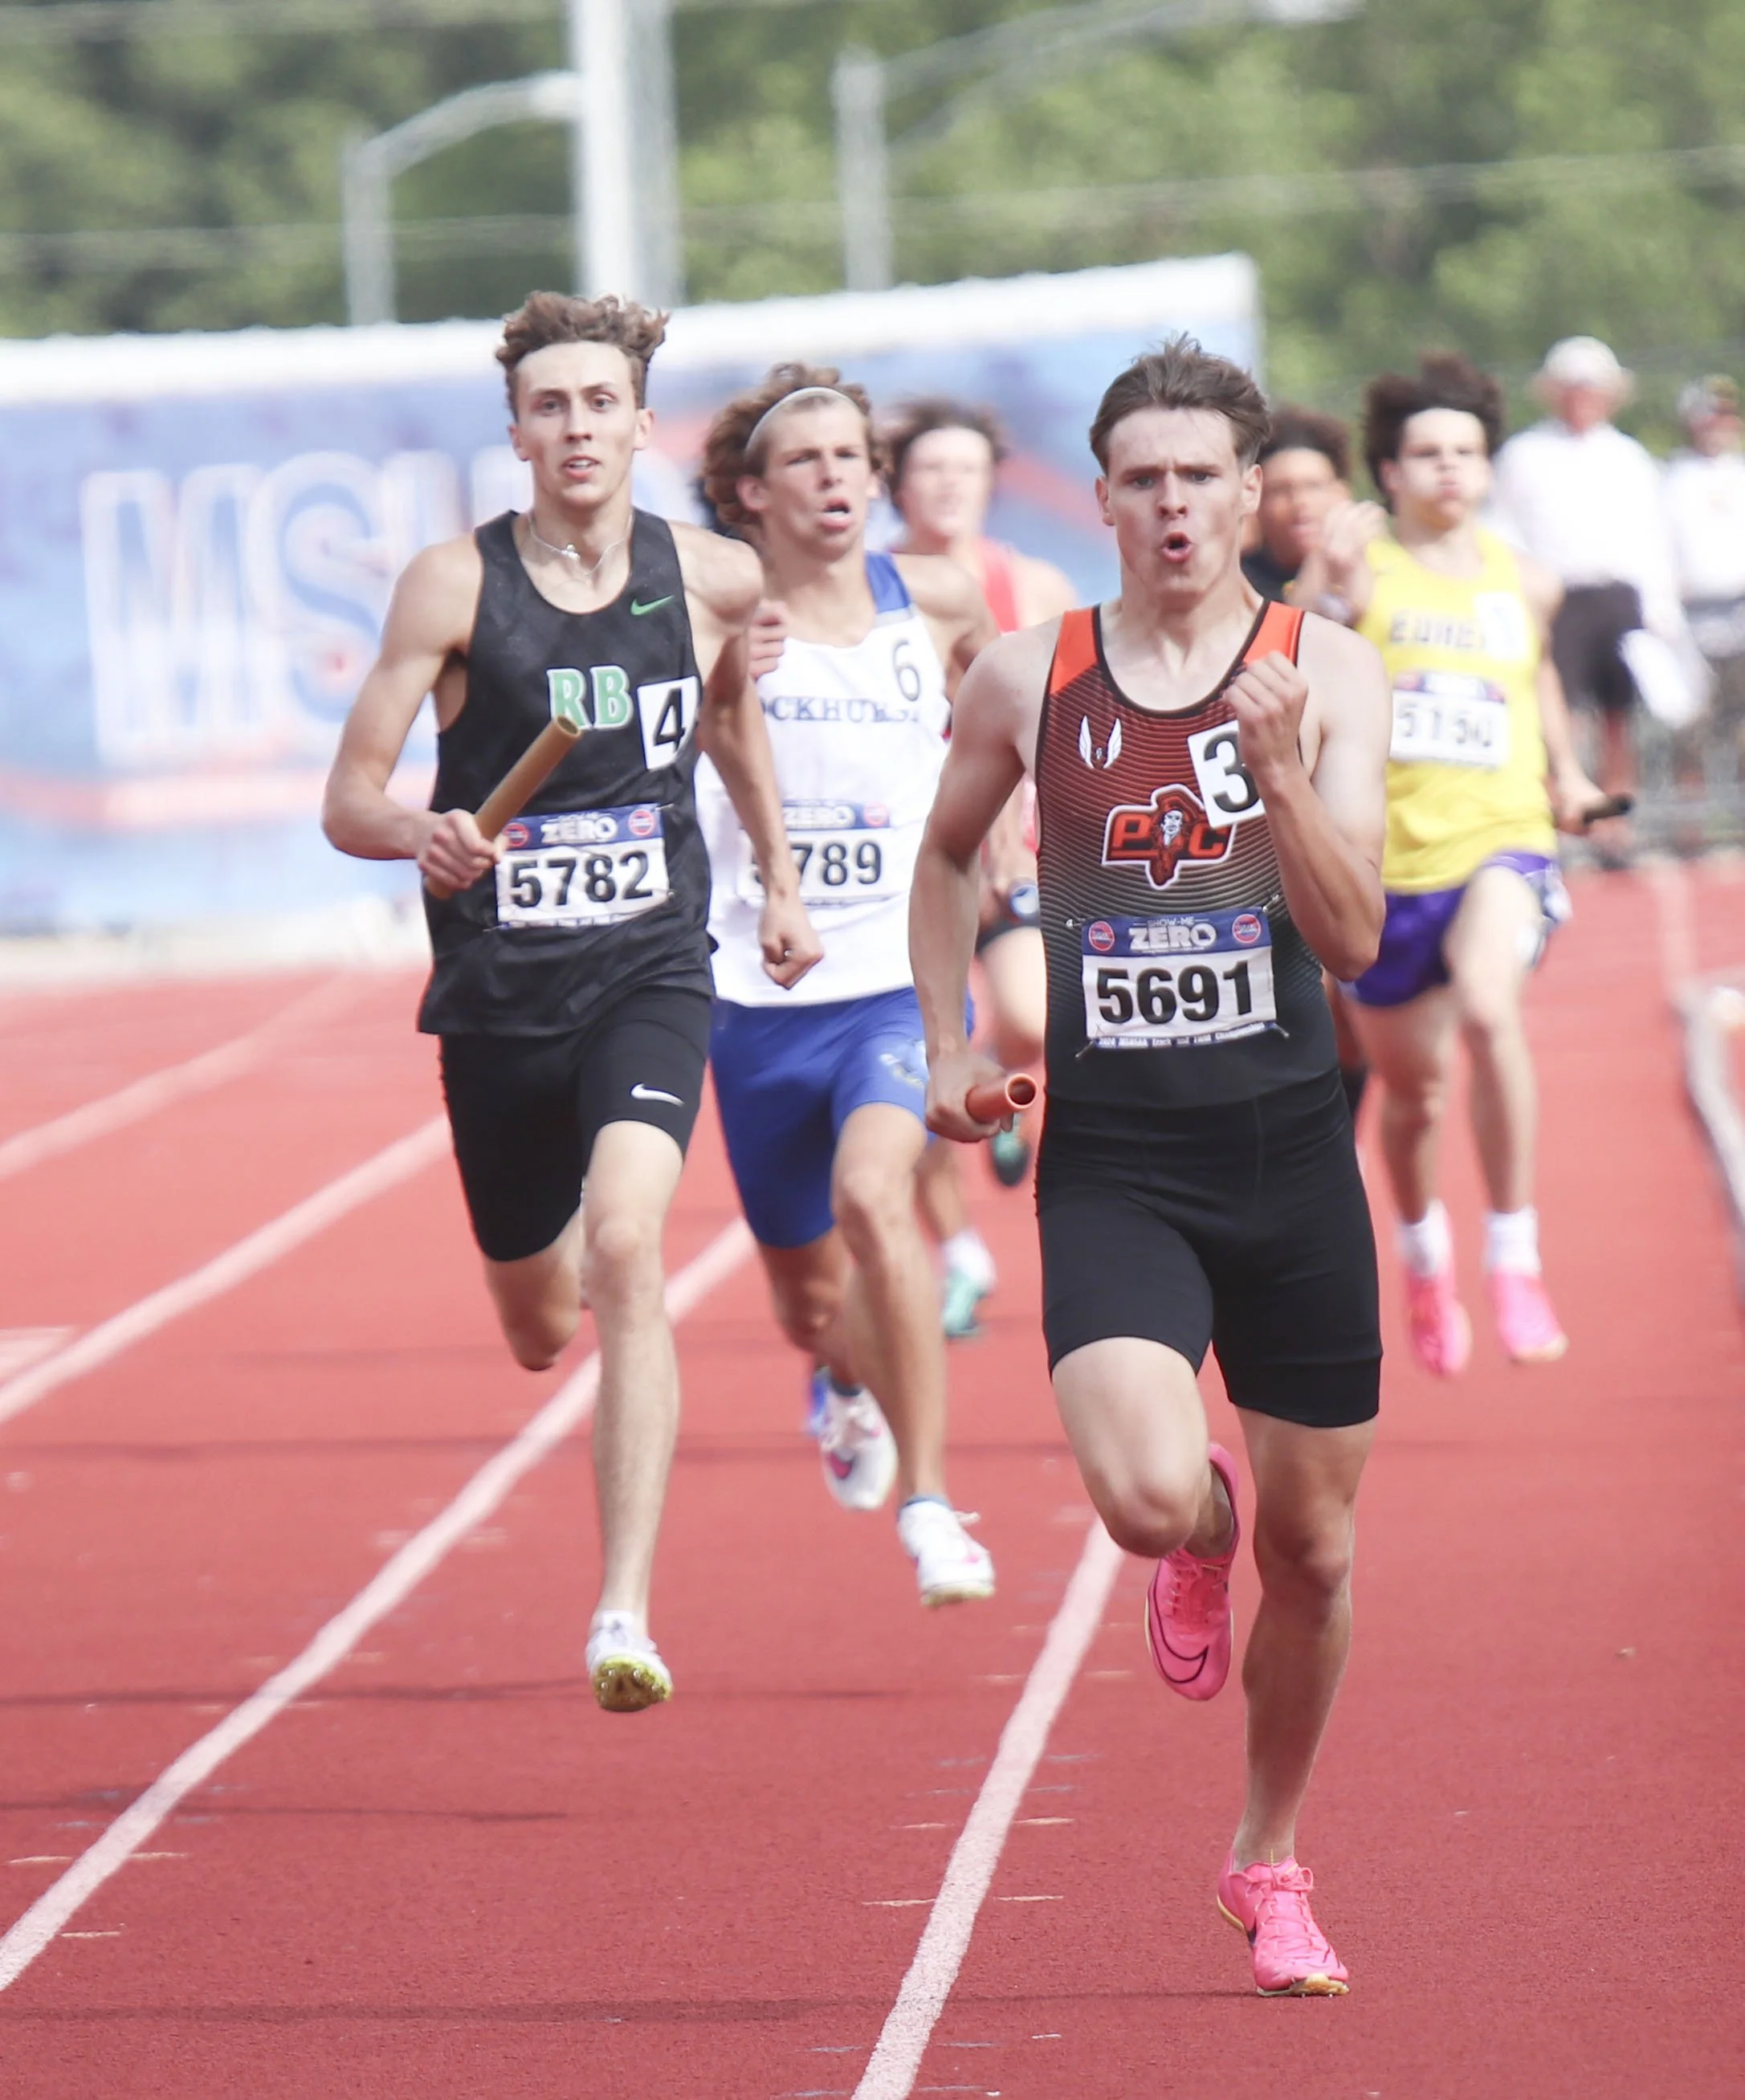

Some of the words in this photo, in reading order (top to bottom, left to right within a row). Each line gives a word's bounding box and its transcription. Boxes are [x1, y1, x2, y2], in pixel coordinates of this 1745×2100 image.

[546, 665, 634, 730] RB
[891, 639, 921, 701] 6
[654, 687, 686, 753] 4
[1204, 732, 1260, 813] 3
[540, 816, 618, 843] ZERO
[509, 850, 653, 908] 5782
[752, 840, 883, 886] 789
[1128, 923, 1217, 952] ZERO
[1096, 960, 1253, 1025] 5691
